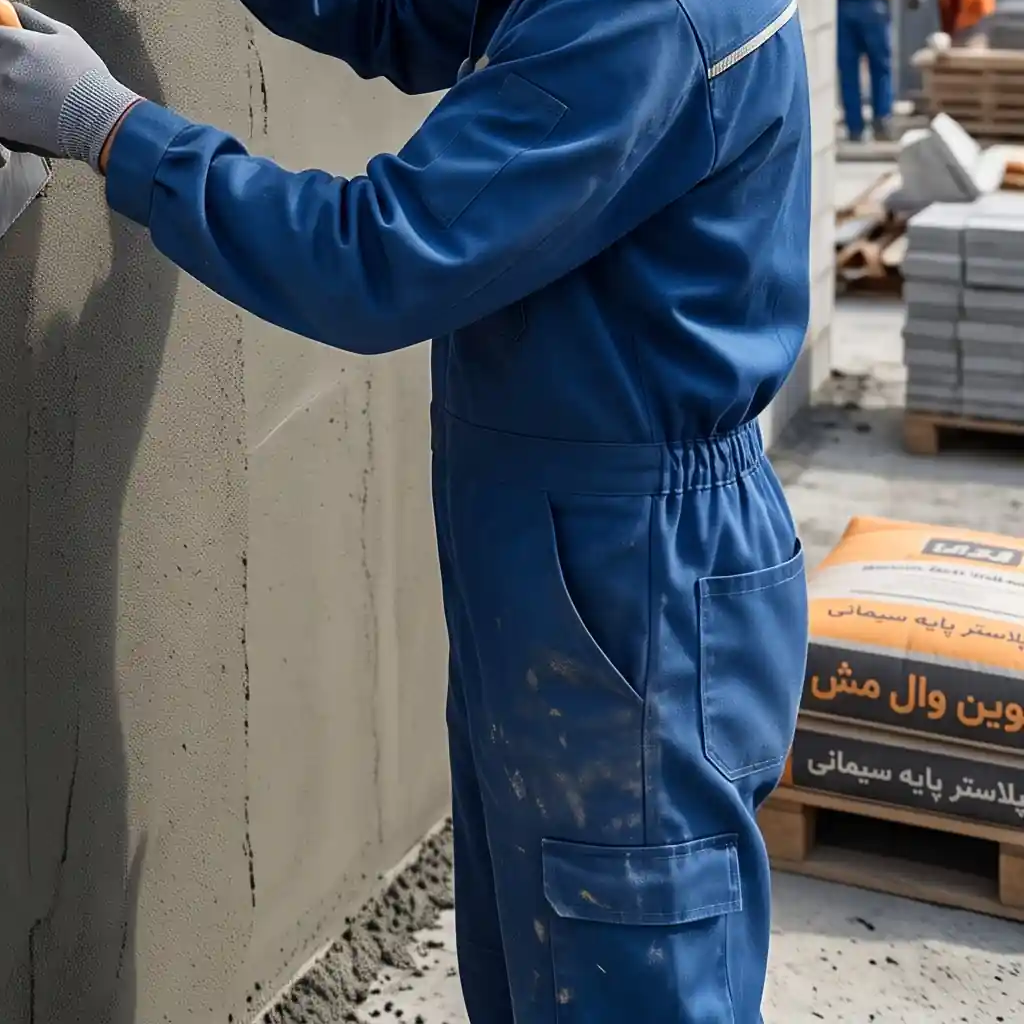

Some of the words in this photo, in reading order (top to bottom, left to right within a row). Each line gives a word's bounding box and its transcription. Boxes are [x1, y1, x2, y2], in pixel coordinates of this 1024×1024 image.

[914, 616, 955, 638] پایه
[811, 661, 881, 700] مش
[889, 673, 947, 719] وال
[956, 694, 1024, 733] وین
[807, 749, 892, 785] سیمانی
[899, 766, 943, 803] پایه
